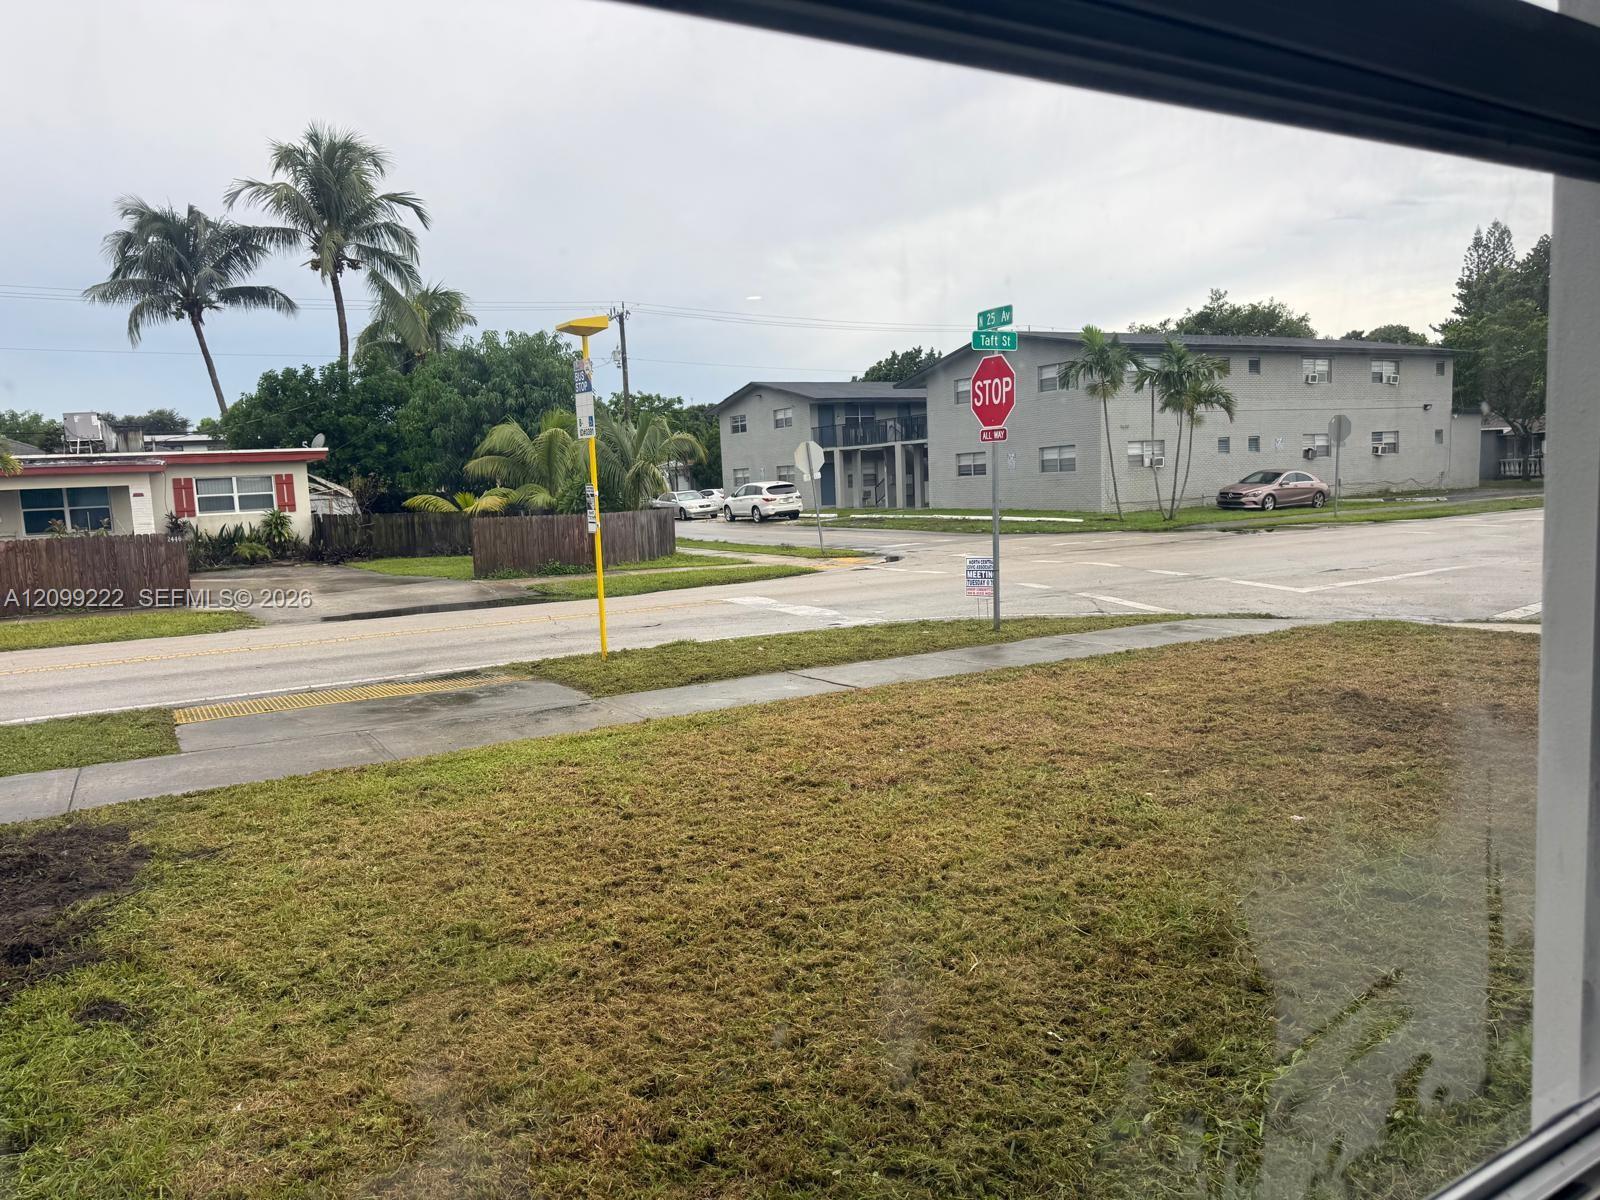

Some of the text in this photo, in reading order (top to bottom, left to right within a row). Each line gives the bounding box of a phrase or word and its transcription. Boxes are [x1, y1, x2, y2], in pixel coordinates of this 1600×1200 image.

[979, 310, 1010, 328] N 25 Av
[980, 334, 1011, 347] Taft St
[574, 372, 584, 381] BUS
[575, 381, 588, 393] STOP
[974, 377, 1012, 407] STOP
[982, 430, 1005, 440] ALL WAY
[967, 570, 993, 579] MEETIN
